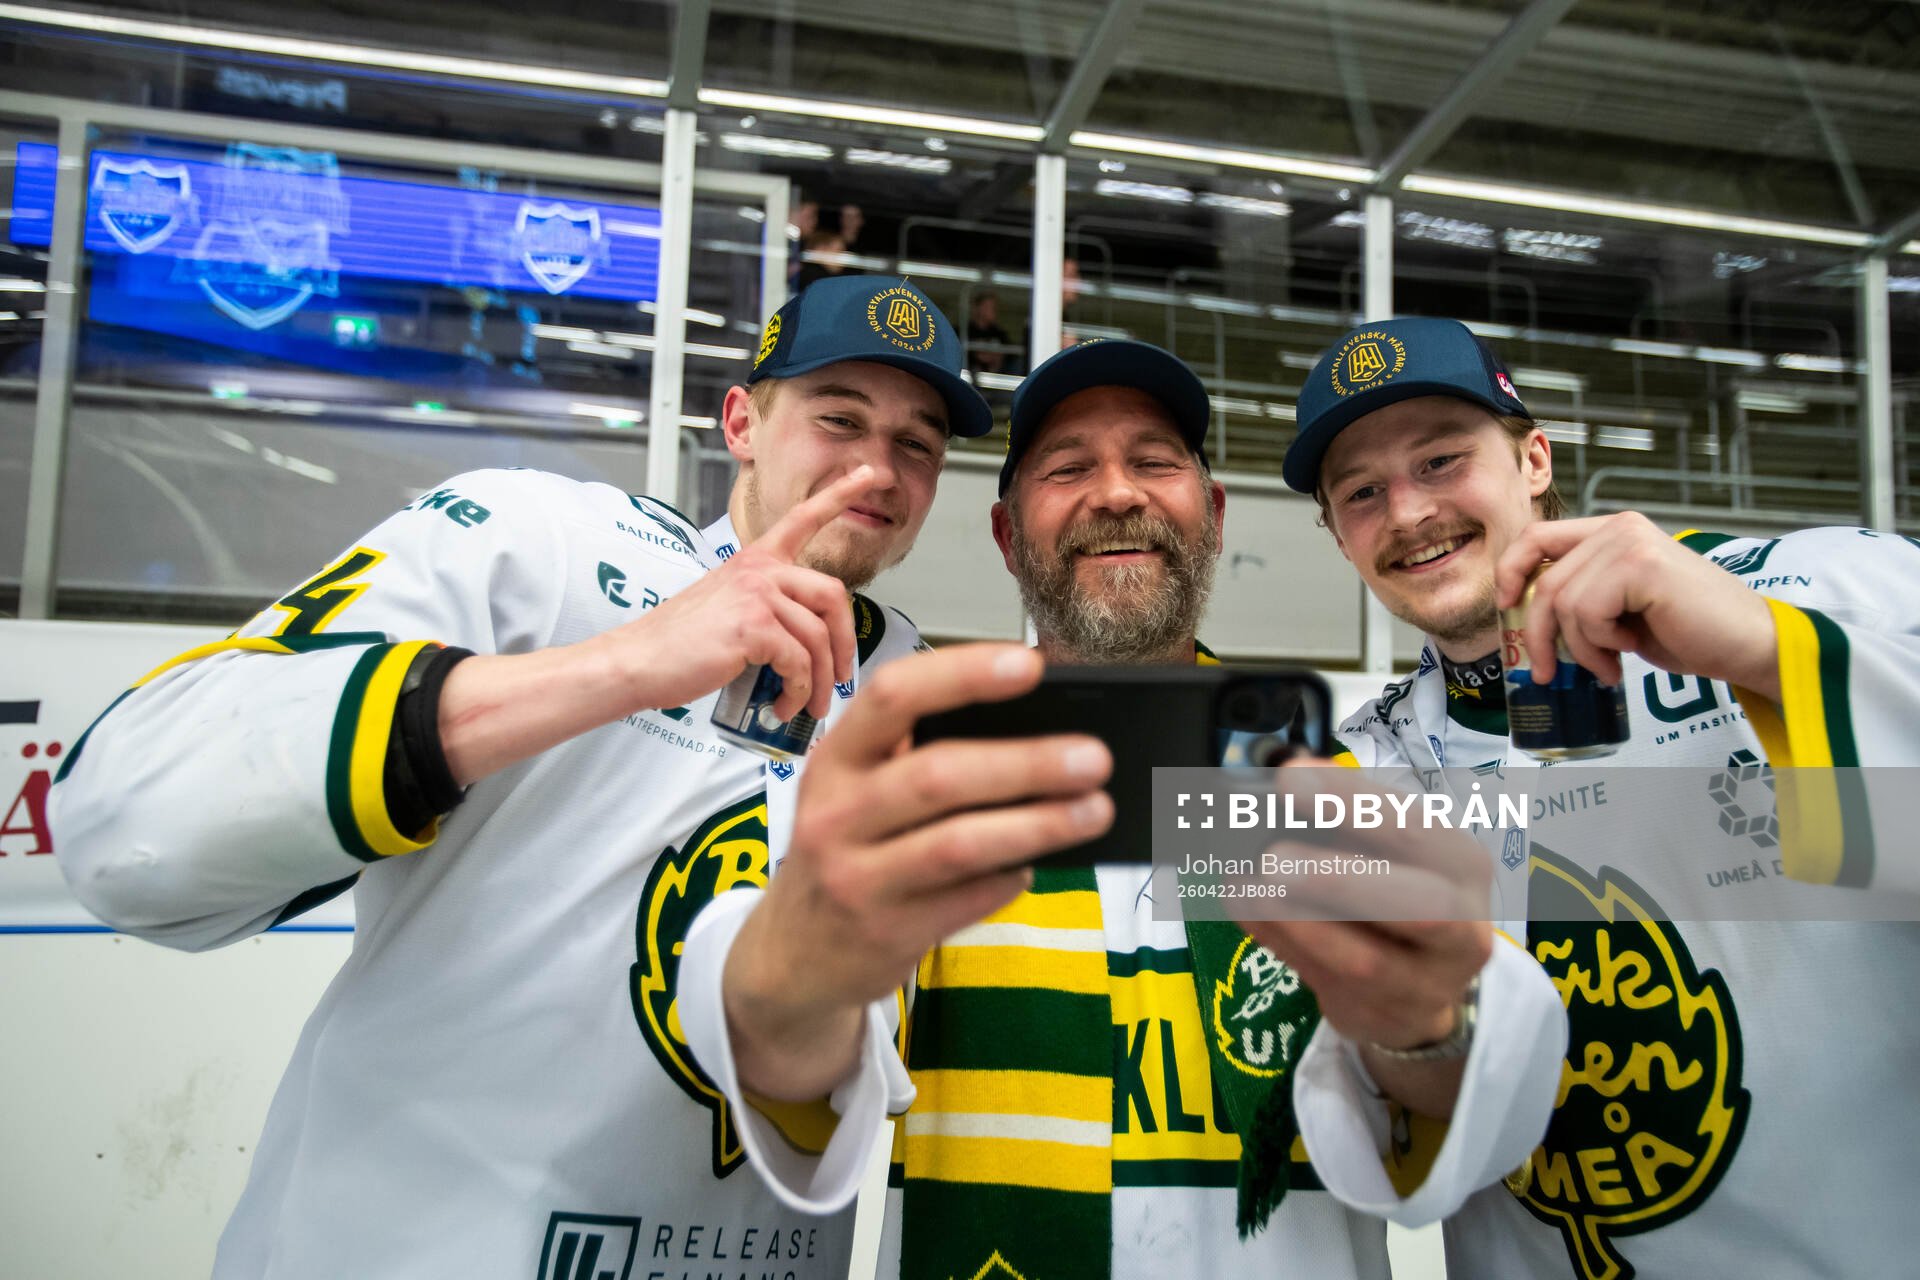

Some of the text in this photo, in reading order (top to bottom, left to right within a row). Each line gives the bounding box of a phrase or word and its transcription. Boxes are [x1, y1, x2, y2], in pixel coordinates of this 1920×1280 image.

[1748, 574, 1813, 590] PPEN
[620, 714, 705, 753] NTREPRENAD
[1655, 730, 1680, 745] UM
[1706, 859, 1767, 888] UMEÅ
[1111, 1017, 1237, 1134] KL
[652, 1224, 817, 1260] RELEASE
